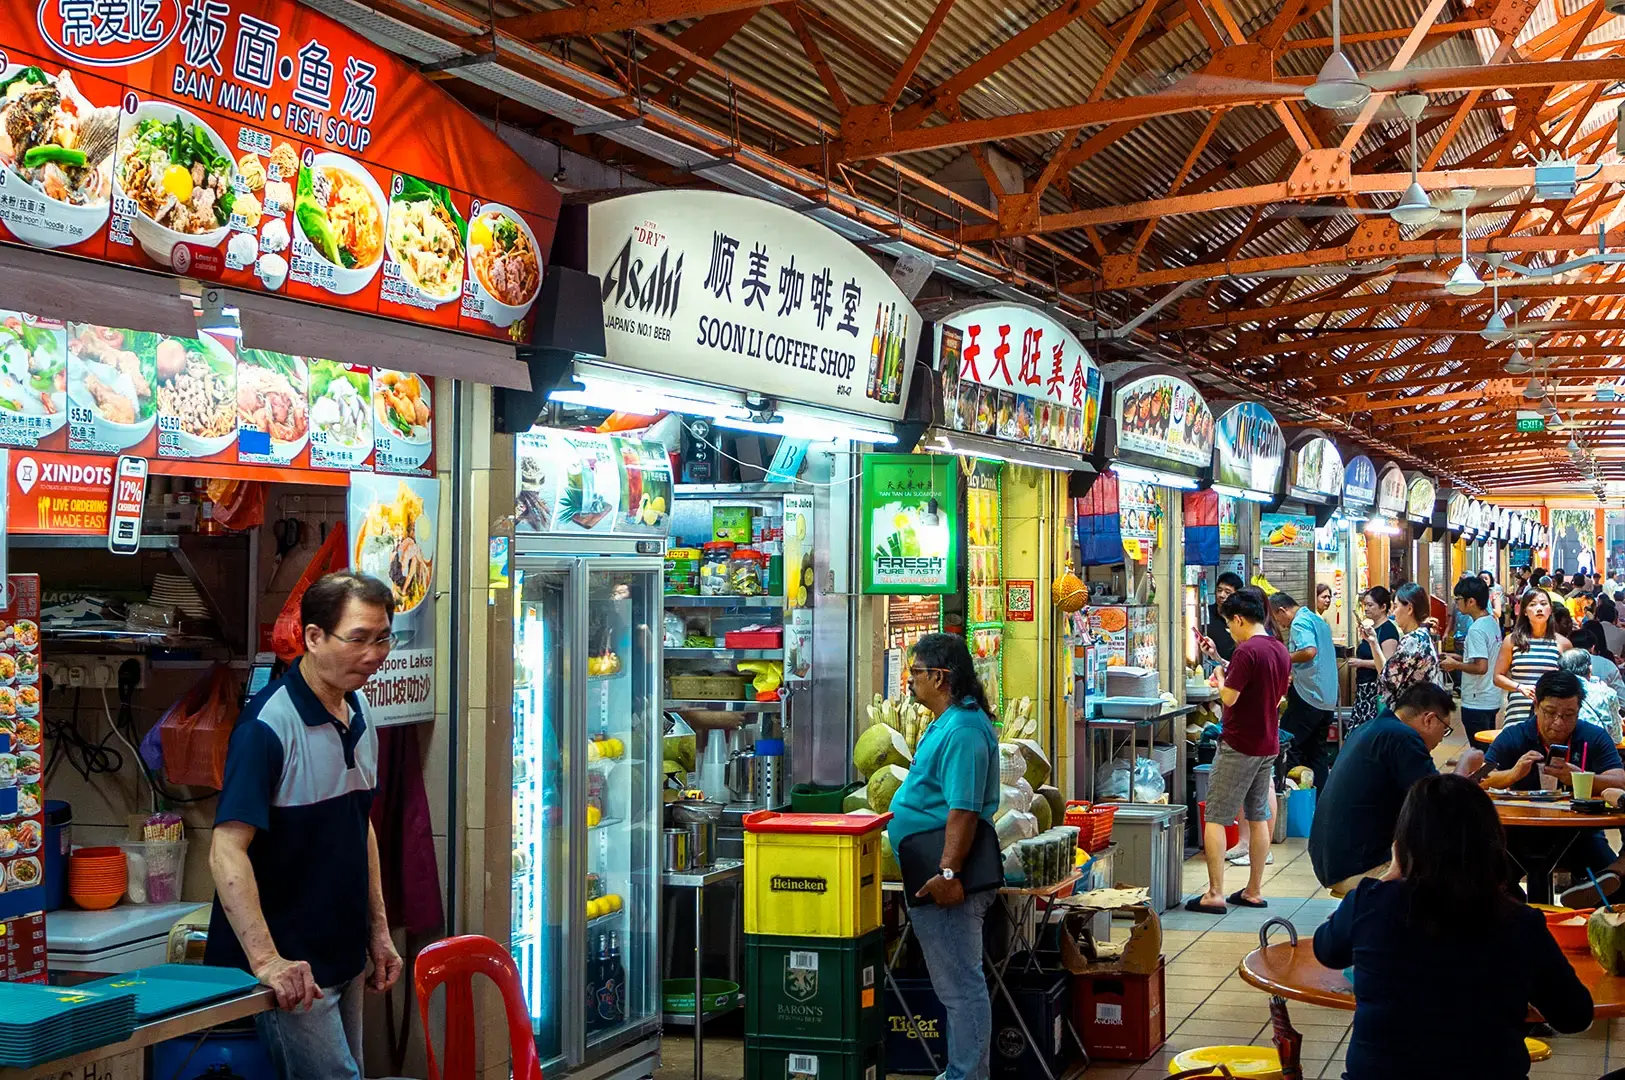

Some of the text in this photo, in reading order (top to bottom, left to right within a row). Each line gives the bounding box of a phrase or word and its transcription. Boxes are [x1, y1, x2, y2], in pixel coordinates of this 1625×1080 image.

[172, 64, 372, 153] BAN MIAN FISH SOUP
[115, 198, 138, 216] $3.50
[294, 241, 312, 257] $4.00
[385, 263, 401, 277] $4.00
[602, 232, 684, 320] Asahi
[465, 281, 479, 295] $4.00
[703, 230, 862, 338] 顺美咖啡室
[605, 315, 671, 342] JAPAN'S NO.1 BEER
[697, 315, 856, 380] SOON LI COFFEE SHOP
[960, 324, 1087, 408] 天天旺美食
[71, 408, 93, 423] $5.50
[160, 416, 180, 430] $3.50
[1522, 420, 1538, 429] EXIT
[780, 445, 798, 469] B
[40, 463, 112, 485] XINDOTS
[119, 480, 142, 502] 12%
[52, 498, 108, 513] LIVE ORDERING
[117, 502, 141, 513] CASHBACK
[52, 514, 107, 529] MADE EASY
[878, 556, 942, 568] FRESH
[409, 653, 433, 668] Laksa
[773, 878, 825, 891] Heineken
[777, 1004, 823, 1016] BARON'S
[888, 1014, 938, 1039] Tiger
[1094, 1018, 1124, 1026] ANCHOR
